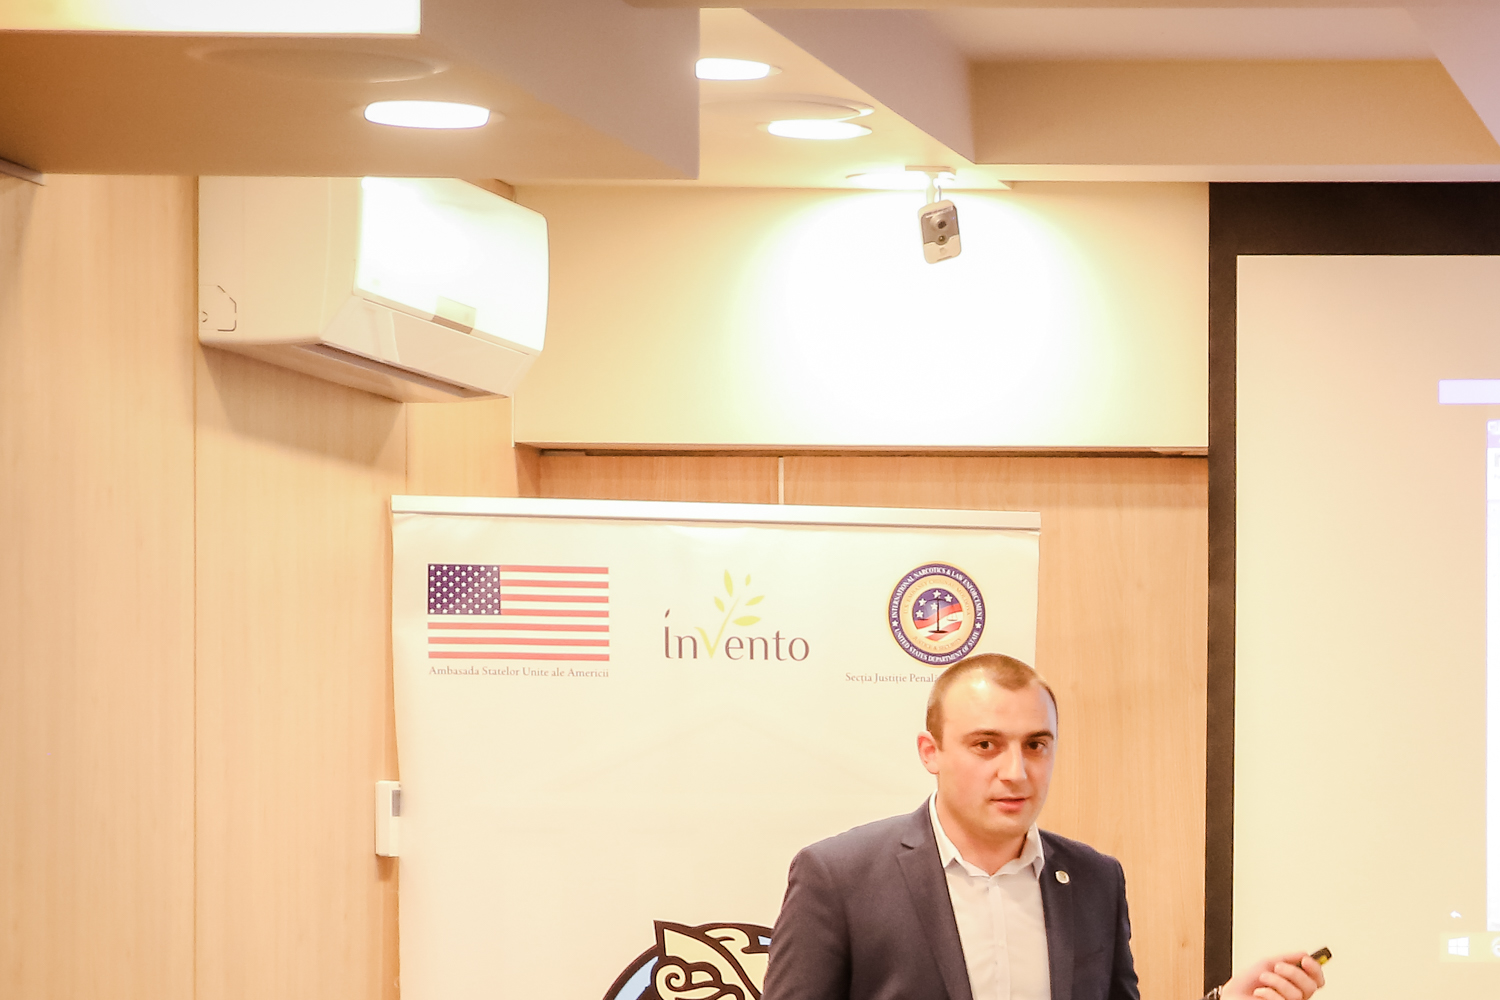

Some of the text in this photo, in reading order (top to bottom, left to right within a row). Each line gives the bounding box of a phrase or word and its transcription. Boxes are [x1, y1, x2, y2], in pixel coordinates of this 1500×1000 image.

[429, 665, 609, 678] Ambasada Statelor Unite ale Americii
